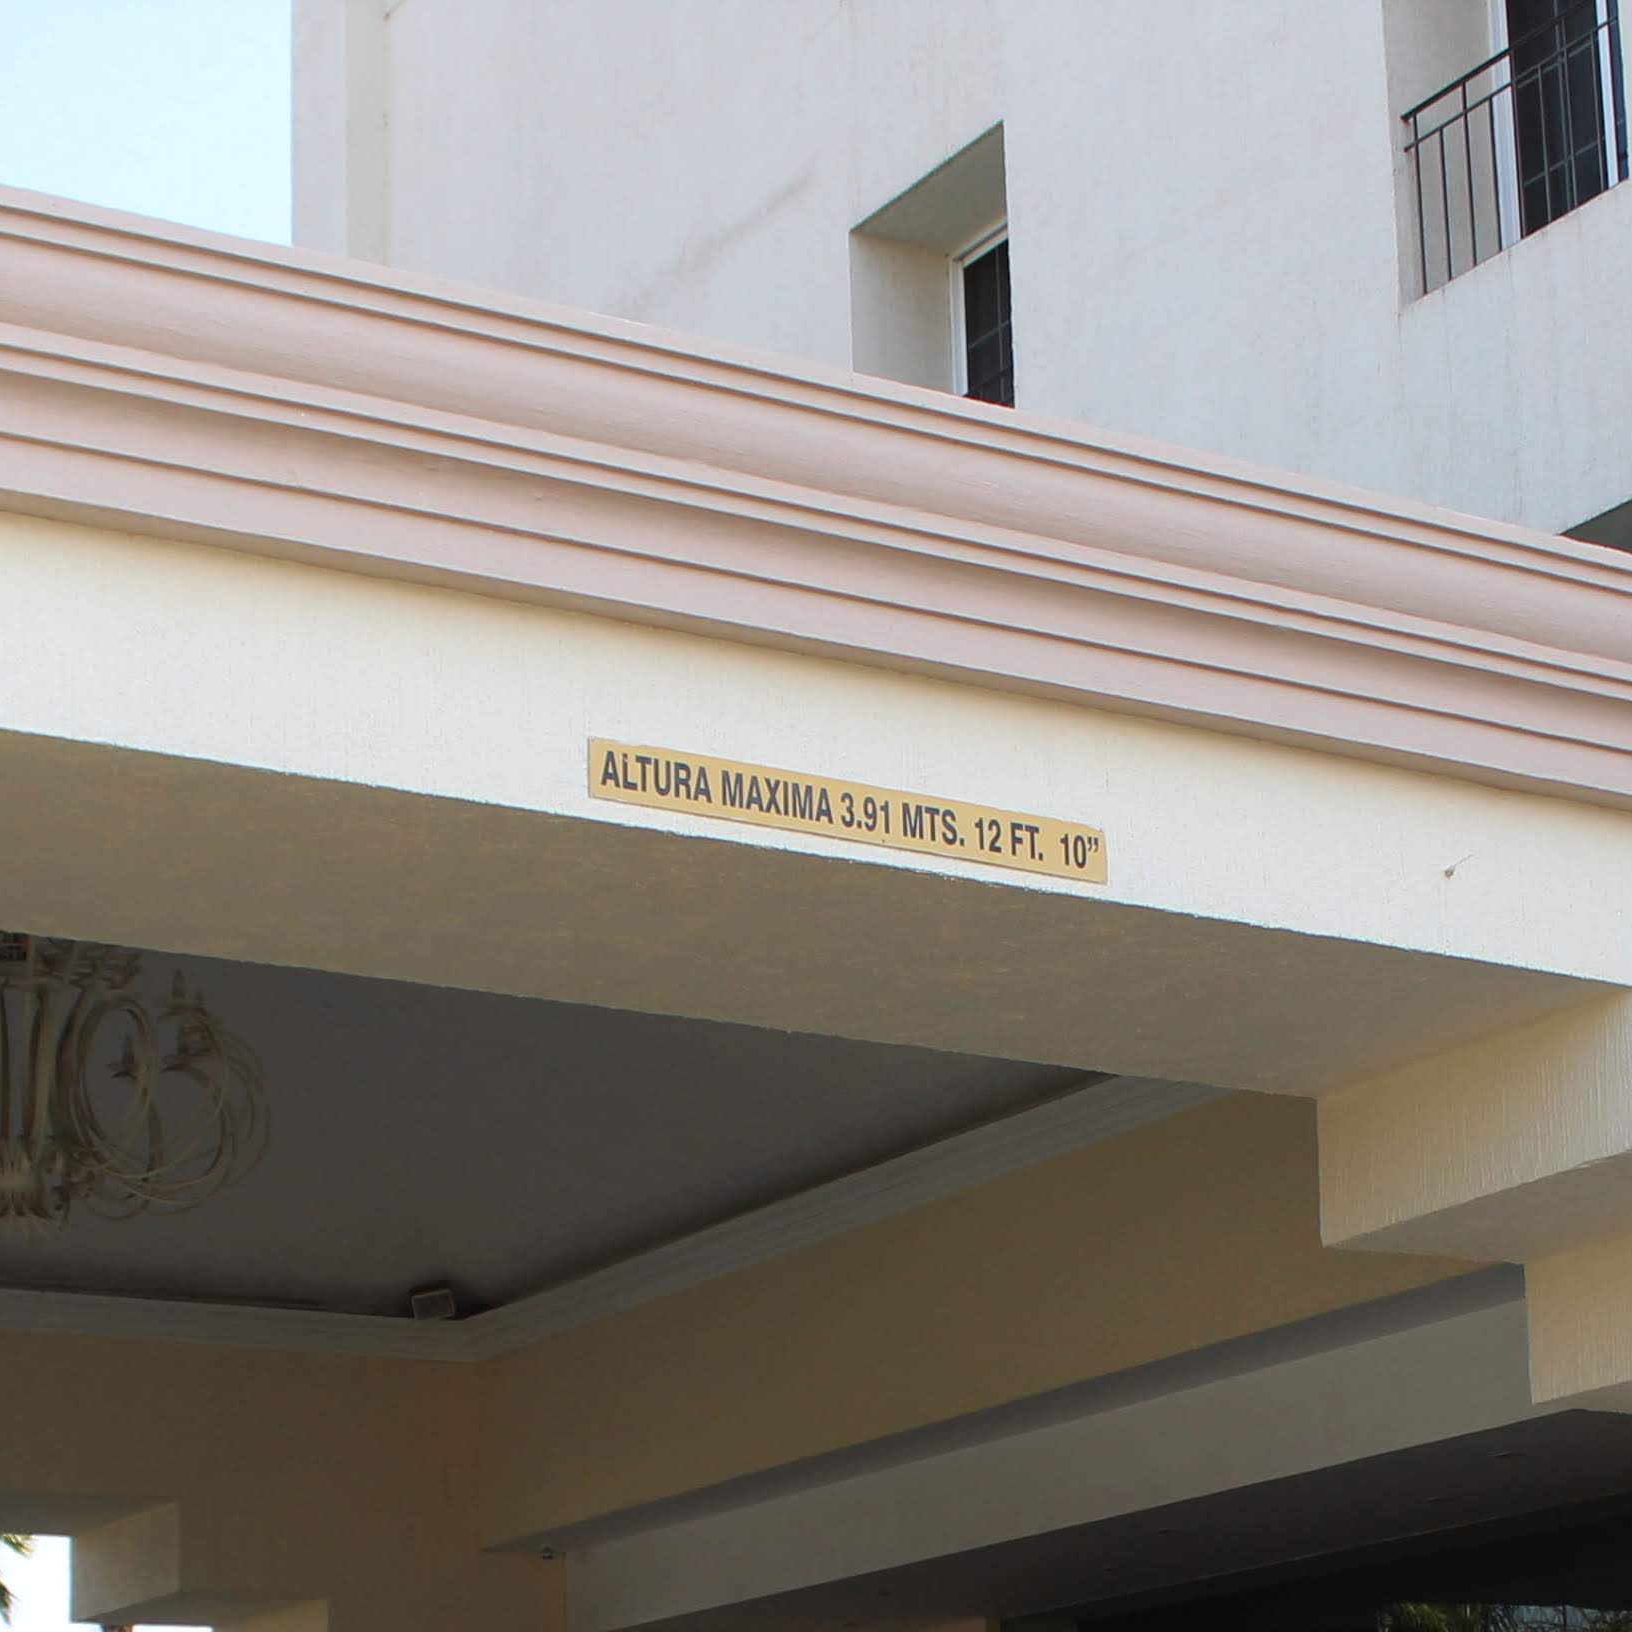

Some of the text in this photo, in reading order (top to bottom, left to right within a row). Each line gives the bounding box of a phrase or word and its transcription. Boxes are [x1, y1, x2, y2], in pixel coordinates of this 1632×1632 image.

[601, 751, 712, 803] ALTURA
[721, 769, 834, 824] MAXIMA
[840, 792, 892, 834] 3.91
[902, 803, 965, 846] MTS.
[974, 817, 1002, 853] 12
[1010, 822, 1044, 861] FT.
